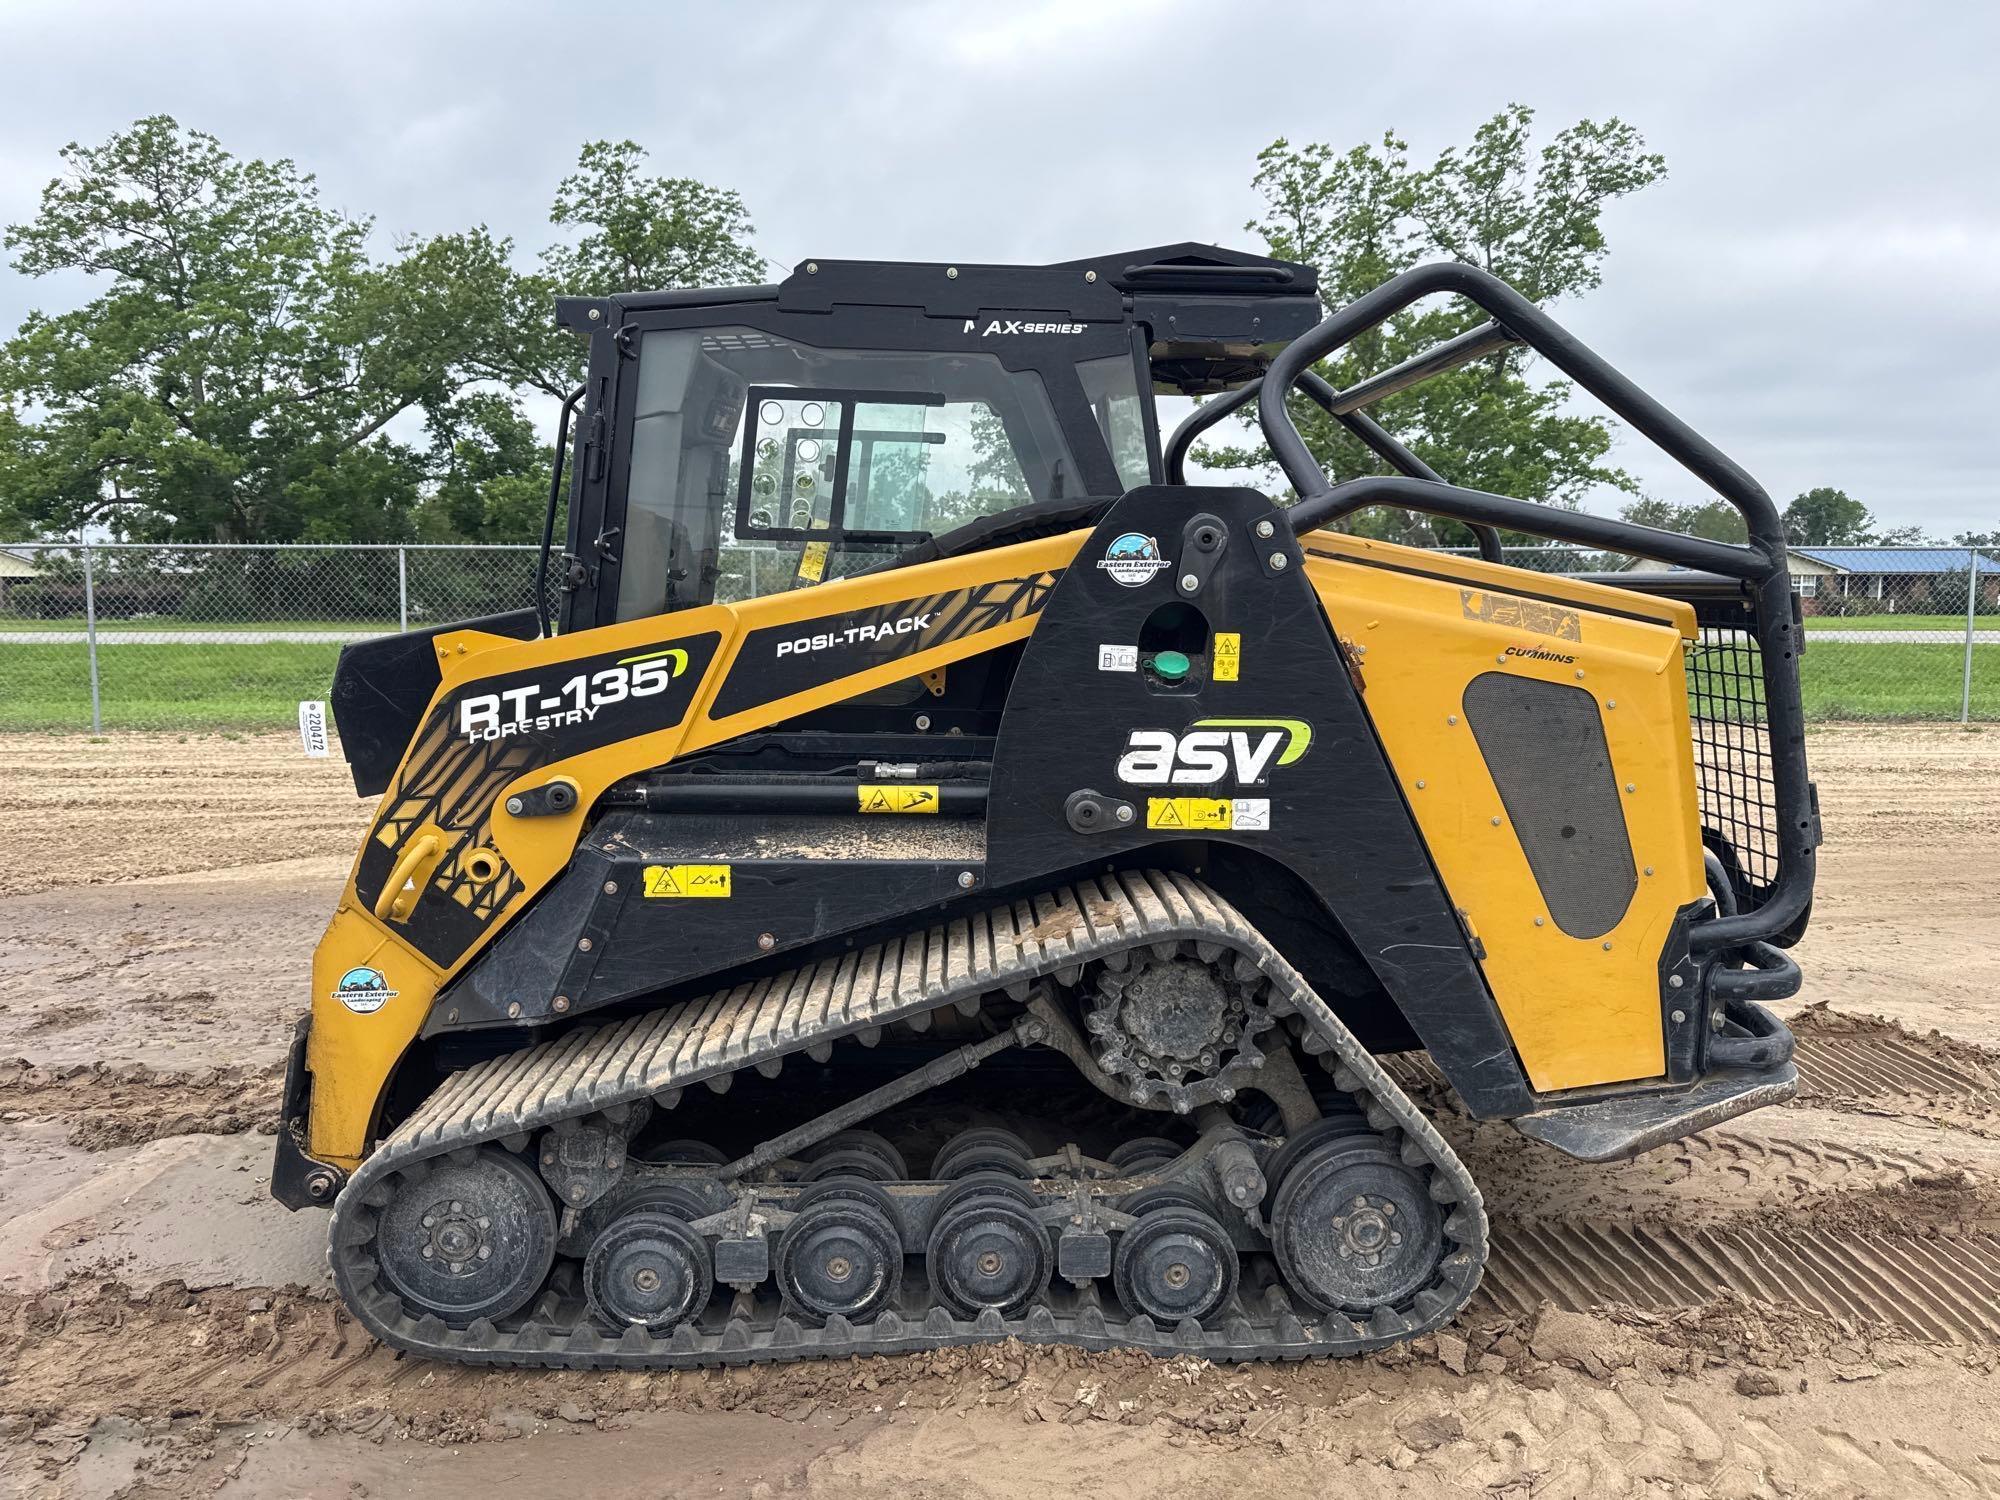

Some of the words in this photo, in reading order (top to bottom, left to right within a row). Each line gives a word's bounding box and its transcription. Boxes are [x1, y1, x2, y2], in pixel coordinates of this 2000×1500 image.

[776, 613, 931, 657] POSI-TRACK
[1504, 646, 1576, 664] CUMMINS
[460, 658, 669, 734] RT-135
[309, 713, 325, 751] 220472
[469, 705, 600, 745] FORESTRY
